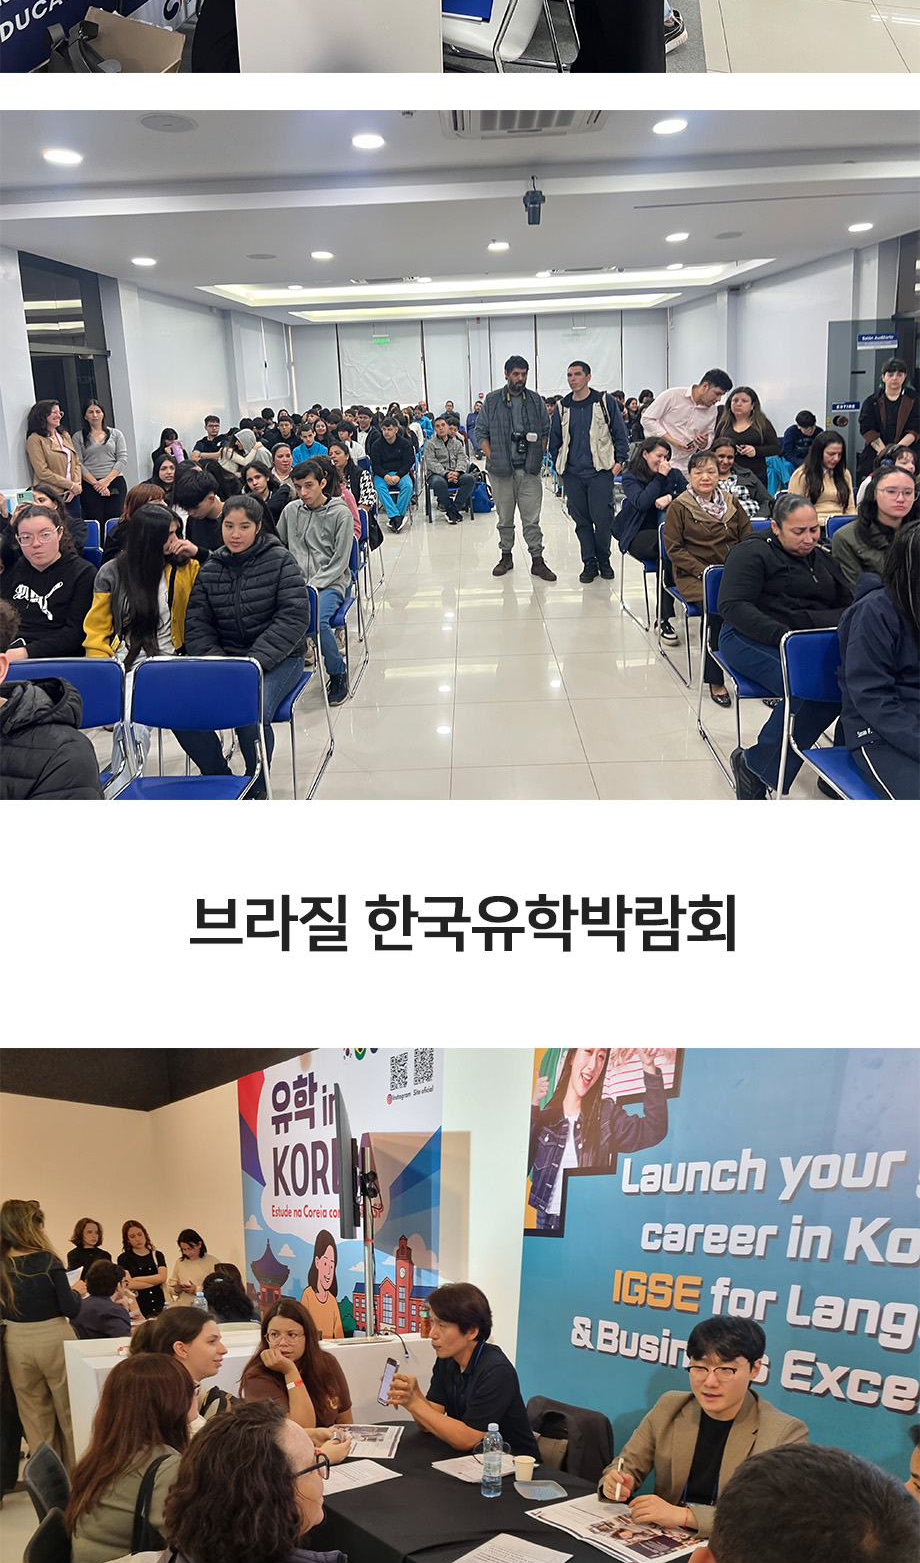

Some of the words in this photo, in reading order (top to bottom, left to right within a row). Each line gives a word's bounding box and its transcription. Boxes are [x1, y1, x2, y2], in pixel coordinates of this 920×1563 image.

[271, 1072, 318, 1135] 유학
[392, 1091, 412, 1102] Instagram
[413, 1087, 421, 1096] Site
[421, 1085, 434, 1096] oficial
[622, 1148, 768, 1194] Launch
[778, 1150, 907, 1201] your
[272, 1204, 293, 1218] Estude
[293, 1207, 303, 1218] na
[303, 1204, 328, 1219] Coreia
[641, 1222, 778, 1257] career
[786, 1215, 833, 1260] in
[612, 1269, 702, 1313] IGSE
[711, 1277, 777, 1322] for
[571, 1315, 595, 1351] &
